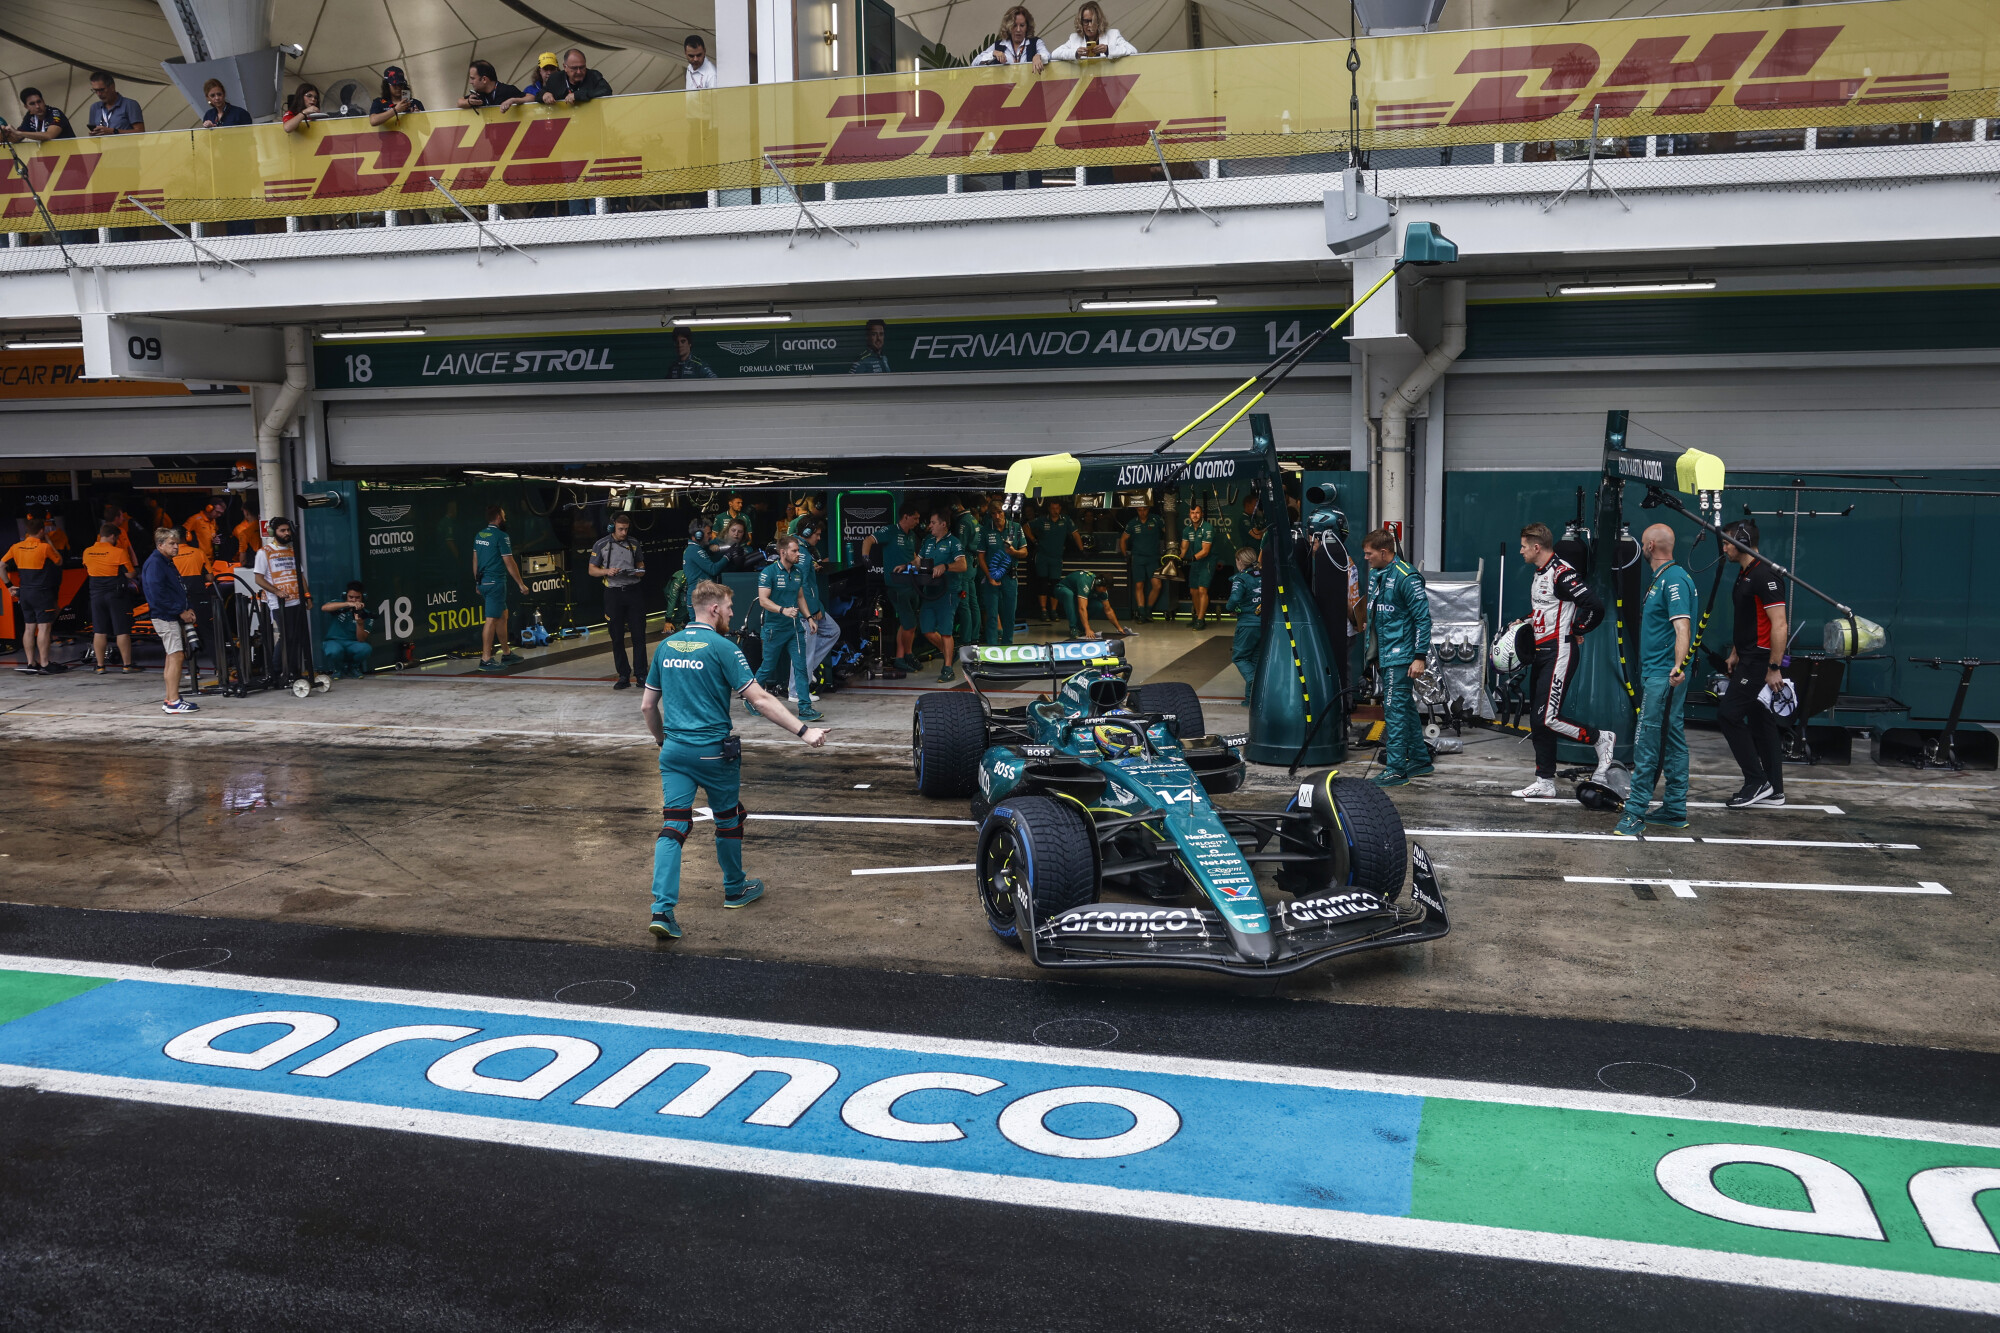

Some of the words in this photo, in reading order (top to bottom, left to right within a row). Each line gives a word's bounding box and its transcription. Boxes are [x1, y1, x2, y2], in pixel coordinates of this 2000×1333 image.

[1447, 25, 1866, 127] DHL
[822, 74, 1162, 166] DHL
[313, 117, 589, 199] DHL
[128, 336, 162, 361] 09
[782, 338, 837, 351] aramco
[910, 331, 1090, 359] FERNANDO
[1093, 325, 1236, 354] ALONSO
[1265, 320, 1301, 356] 14
[344, 354, 373, 383] 18
[422, 352, 511, 376] LANCE
[512, 348, 614, 373] STROLL
[740, 364, 773, 373] FORMULA
[794, 362, 814, 371] TEAM
[1117, 466, 1152, 485] ASTON
[1195, 459, 1235, 480] aramco
[369, 531, 414, 546] aramco
[427, 590, 459, 606] LANCE
[378, 596, 414, 641] 18
[428, 605, 486, 633] STROLL
[985, 642, 1102, 661] aramco
[663, 658, 704, 670] aramco
[1027, 749, 1051, 757] BOSS
[1227, 737, 1247, 747] BOSS
[993, 760, 1016, 780] BOSS
[1156, 789, 1203, 805] 14
[1184, 833, 1226, 841] NexGen
[1199, 859, 1242, 867] NetApp
[1212, 877, 1250, 885] PIRELLI
[1017, 883, 1028, 909] BOSS
[1290, 891, 1380, 922] aramco
[1061, 909, 1188, 932] aramco
[163, 1010, 1181, 1160] aramco
